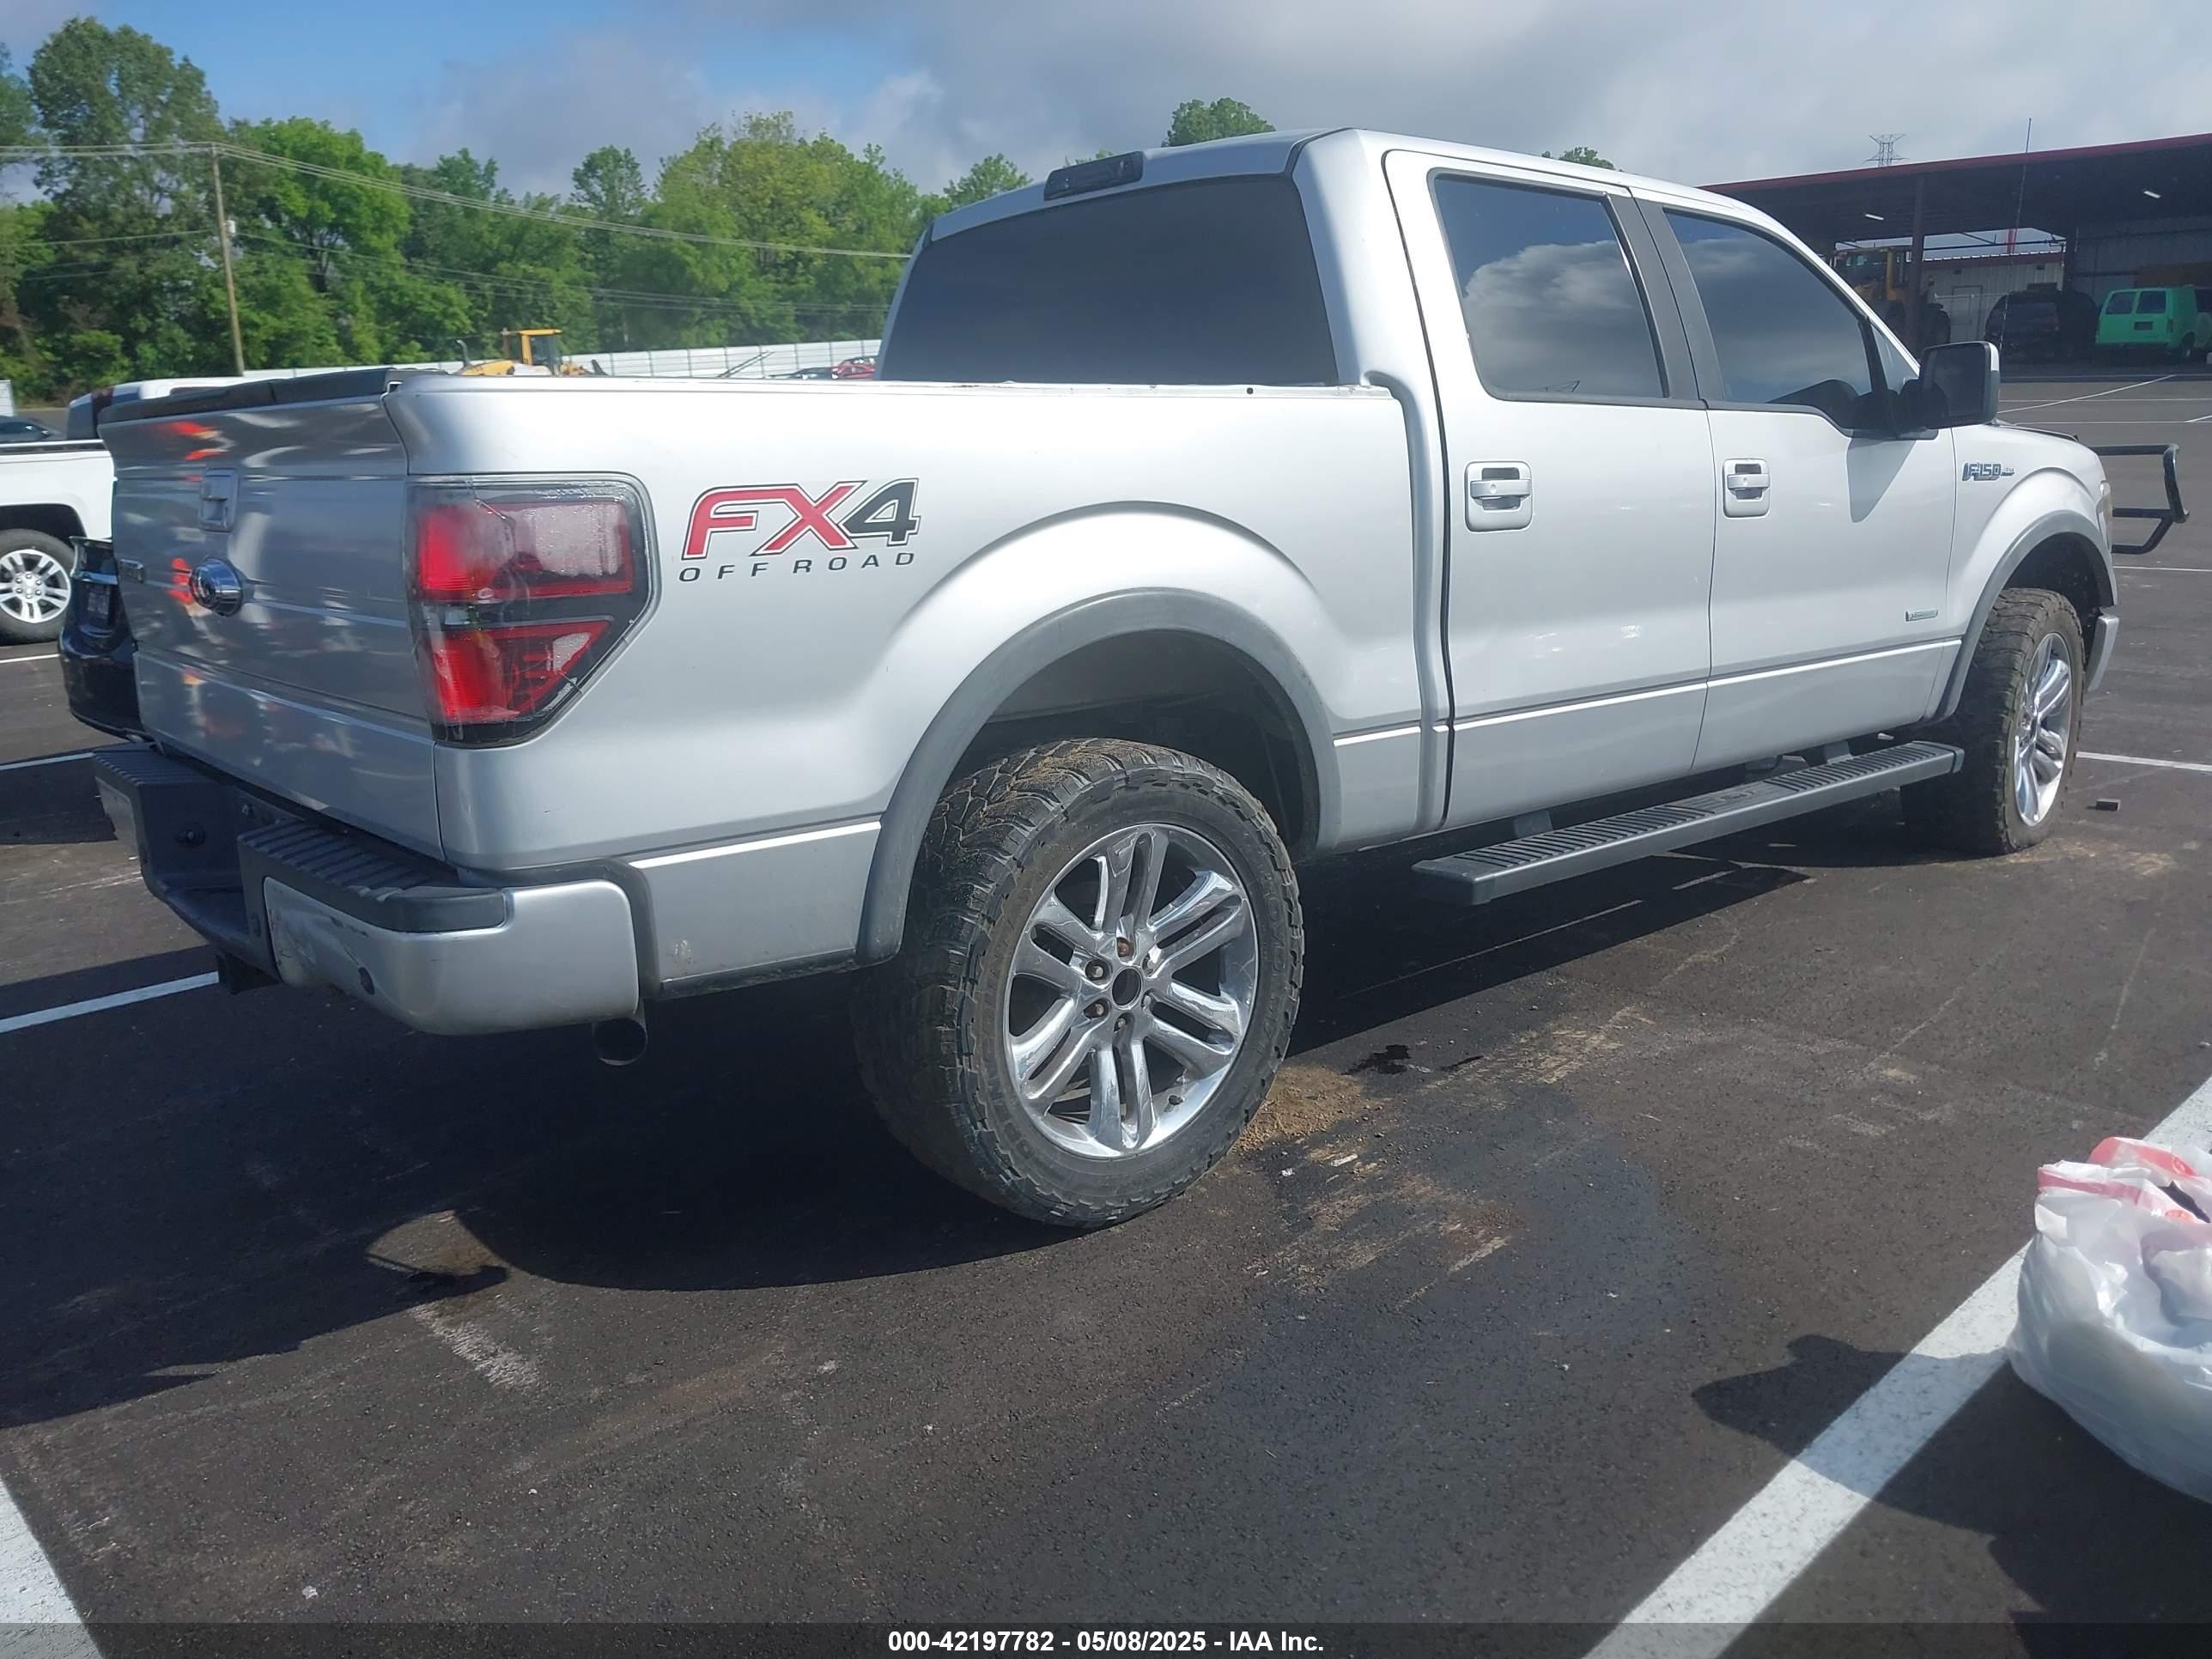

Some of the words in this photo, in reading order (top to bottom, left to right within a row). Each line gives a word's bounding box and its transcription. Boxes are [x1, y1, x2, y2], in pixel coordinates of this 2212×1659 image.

[680, 477, 921, 560] FX4
[678, 562, 769, 581] OFF
[793, 552, 915, 574] ROAD
